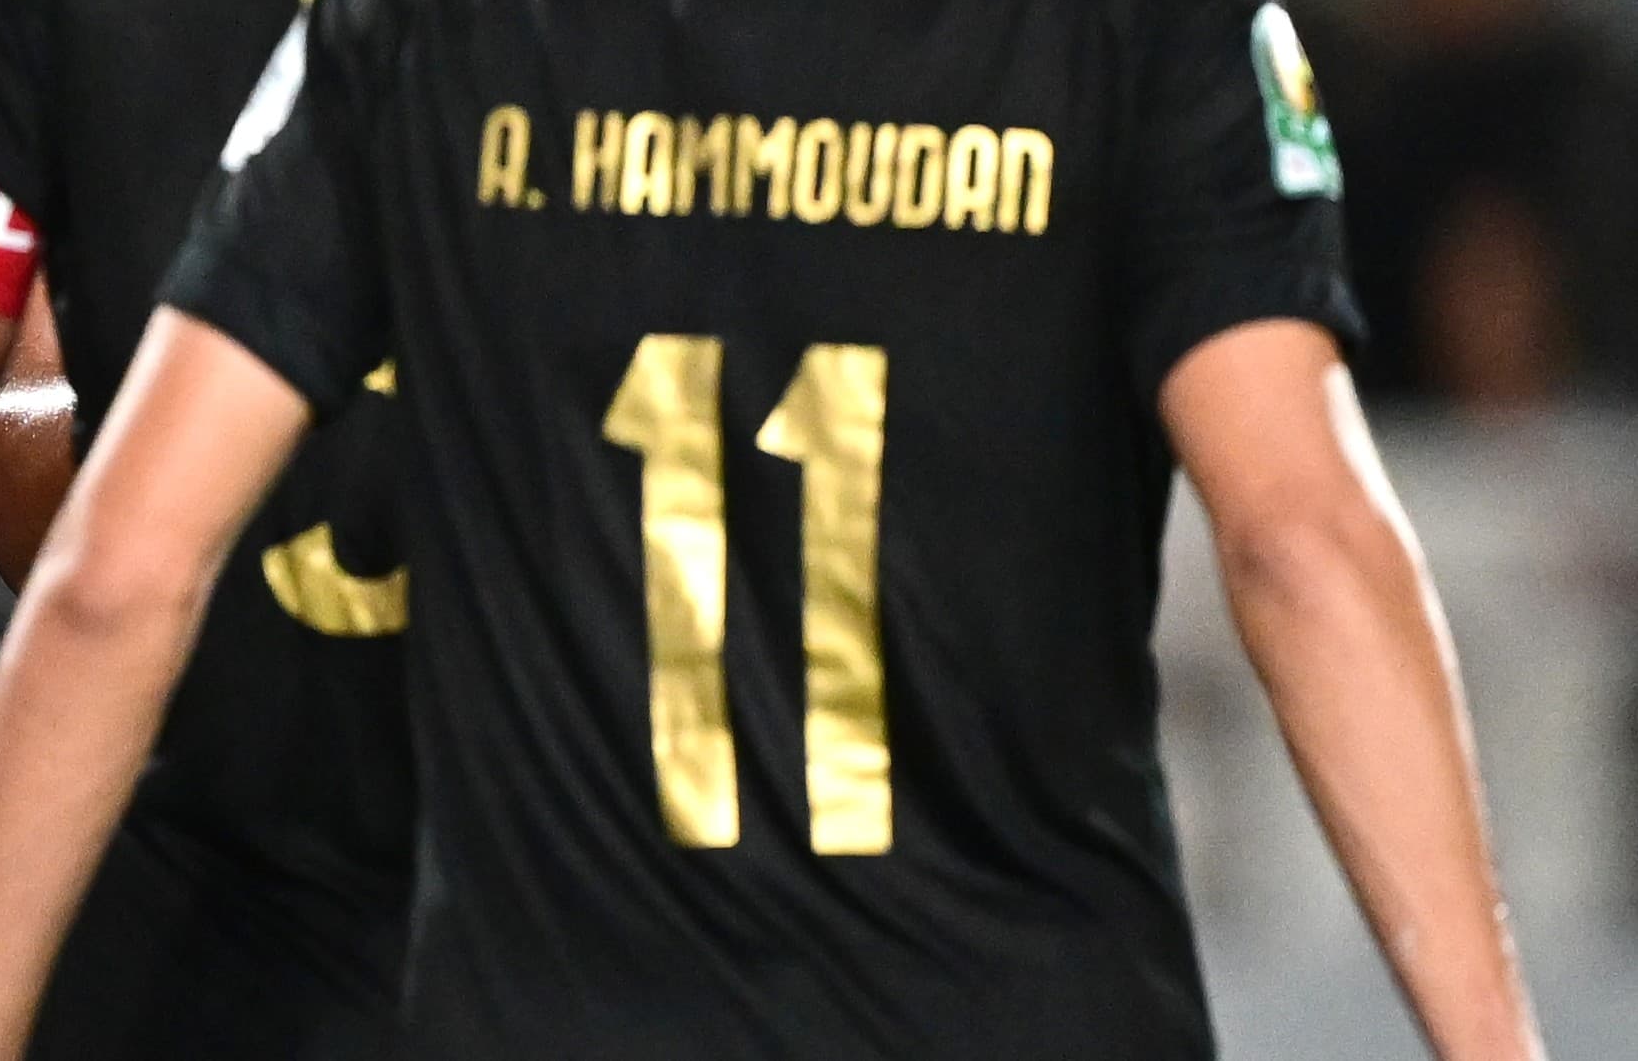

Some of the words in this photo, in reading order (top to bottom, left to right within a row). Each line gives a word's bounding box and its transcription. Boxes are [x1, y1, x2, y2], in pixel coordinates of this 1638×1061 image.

[476, 103, 547, 212] A.
[571, 108, 1054, 236] HAMMOUDAN
[602, 333, 893, 855] 11
